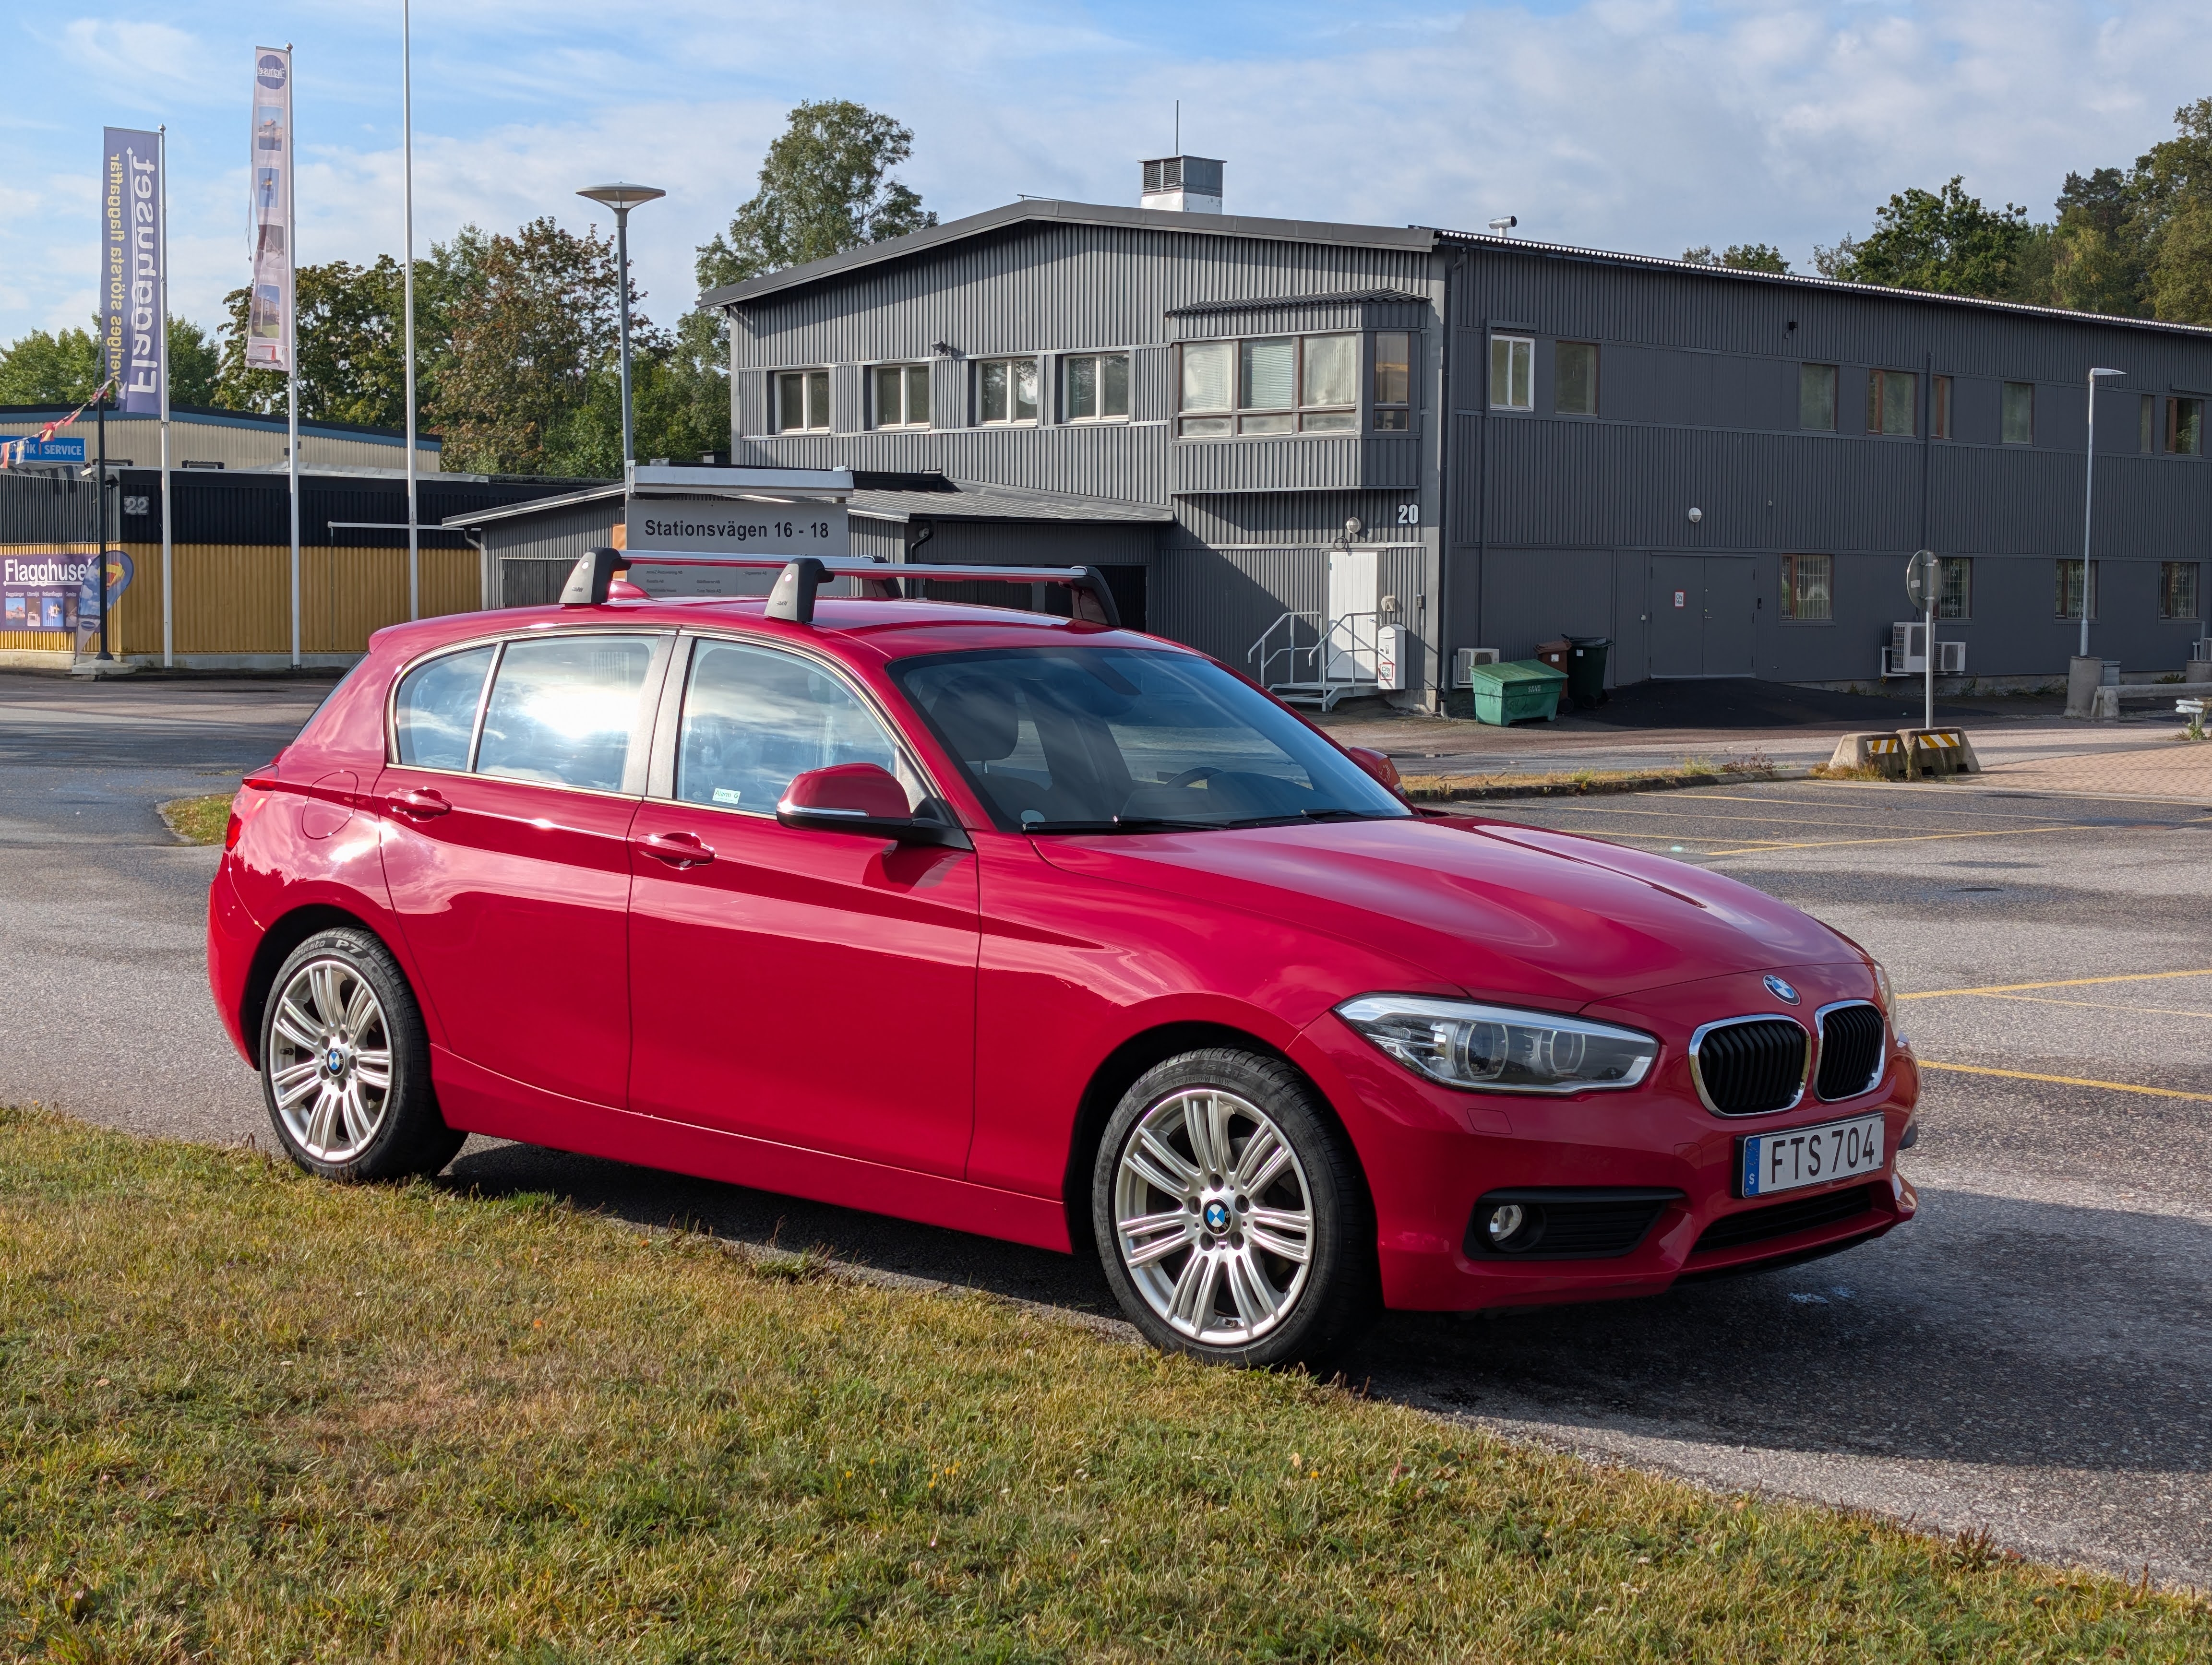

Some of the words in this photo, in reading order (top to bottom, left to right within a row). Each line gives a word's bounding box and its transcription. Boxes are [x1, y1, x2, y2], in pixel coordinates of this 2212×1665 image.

[44, 445, 82, 455] SERVICE
[126, 497, 147, 513] 22
[1398, 504, 1419, 523] 20
[645, 520, 767, 541] Stationsvägen
[775, 522, 792, 537] 16
[811, 522, 828, 538] 18
[335, 939, 363, 954] P7
[1772, 1134, 1821, 1184] FTS
[1831, 1123, 1875, 1173] 704
[1749, 1173, 1755, 1185] S
[1214, 1211, 1230, 1233] BMW
